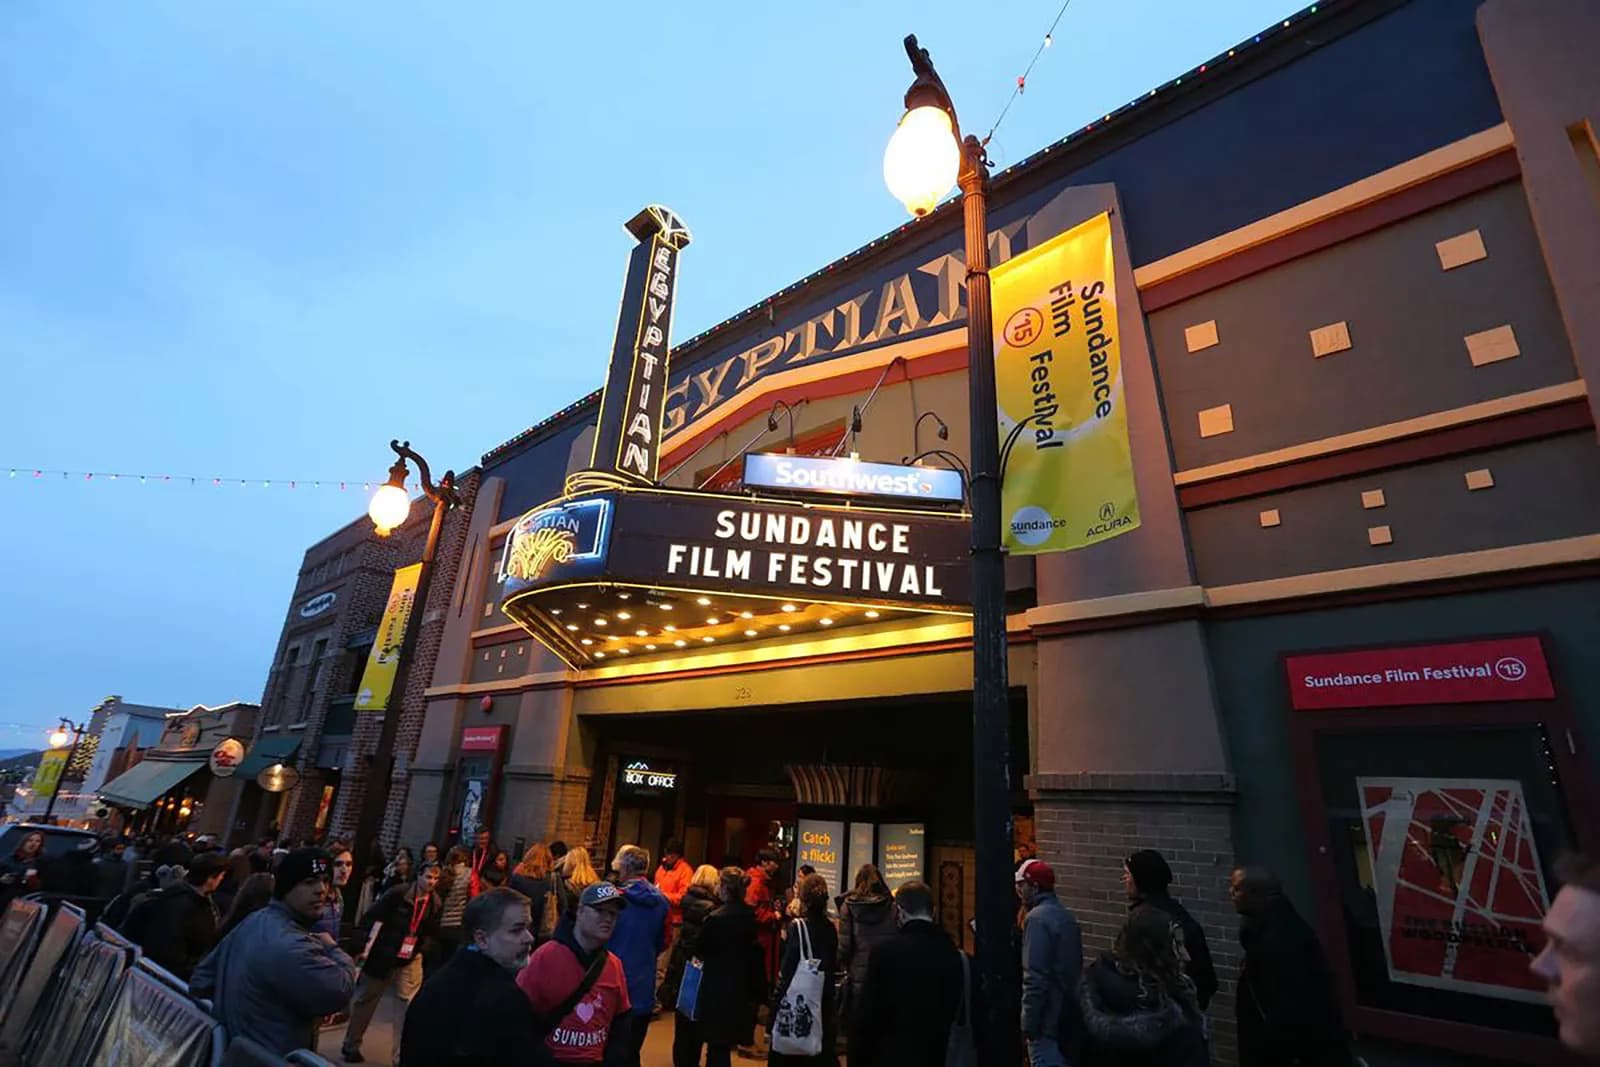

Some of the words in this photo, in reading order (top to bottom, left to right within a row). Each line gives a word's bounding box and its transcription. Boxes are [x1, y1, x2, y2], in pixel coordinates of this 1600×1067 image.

[662, 216, 1031, 436] GYPTIAN
[1049, 280, 1076, 338] Film
[623, 246, 671, 476] EGYPTIAN
[1081, 280, 1113, 419] Sundance
[1030, 349, 1064, 450] Festival
[774, 461, 922, 495] Southwest
[714, 509, 910, 554] SUNDANCE
[1010, 518, 1067, 532] sundance
[1086, 515, 1132, 538] ACURA
[666, 543, 752, 581] FILM
[767, 551, 943, 597] FESTIVAL
[1304, 672, 1382, 688] Sundance
[1385, 669, 1420, 683] Film
[1423, 662, 1492, 681] Festival
[625, 772, 644, 785] BOX
[647, 775, 676, 789] OFFICE
[802, 831, 832, 846] Catch
